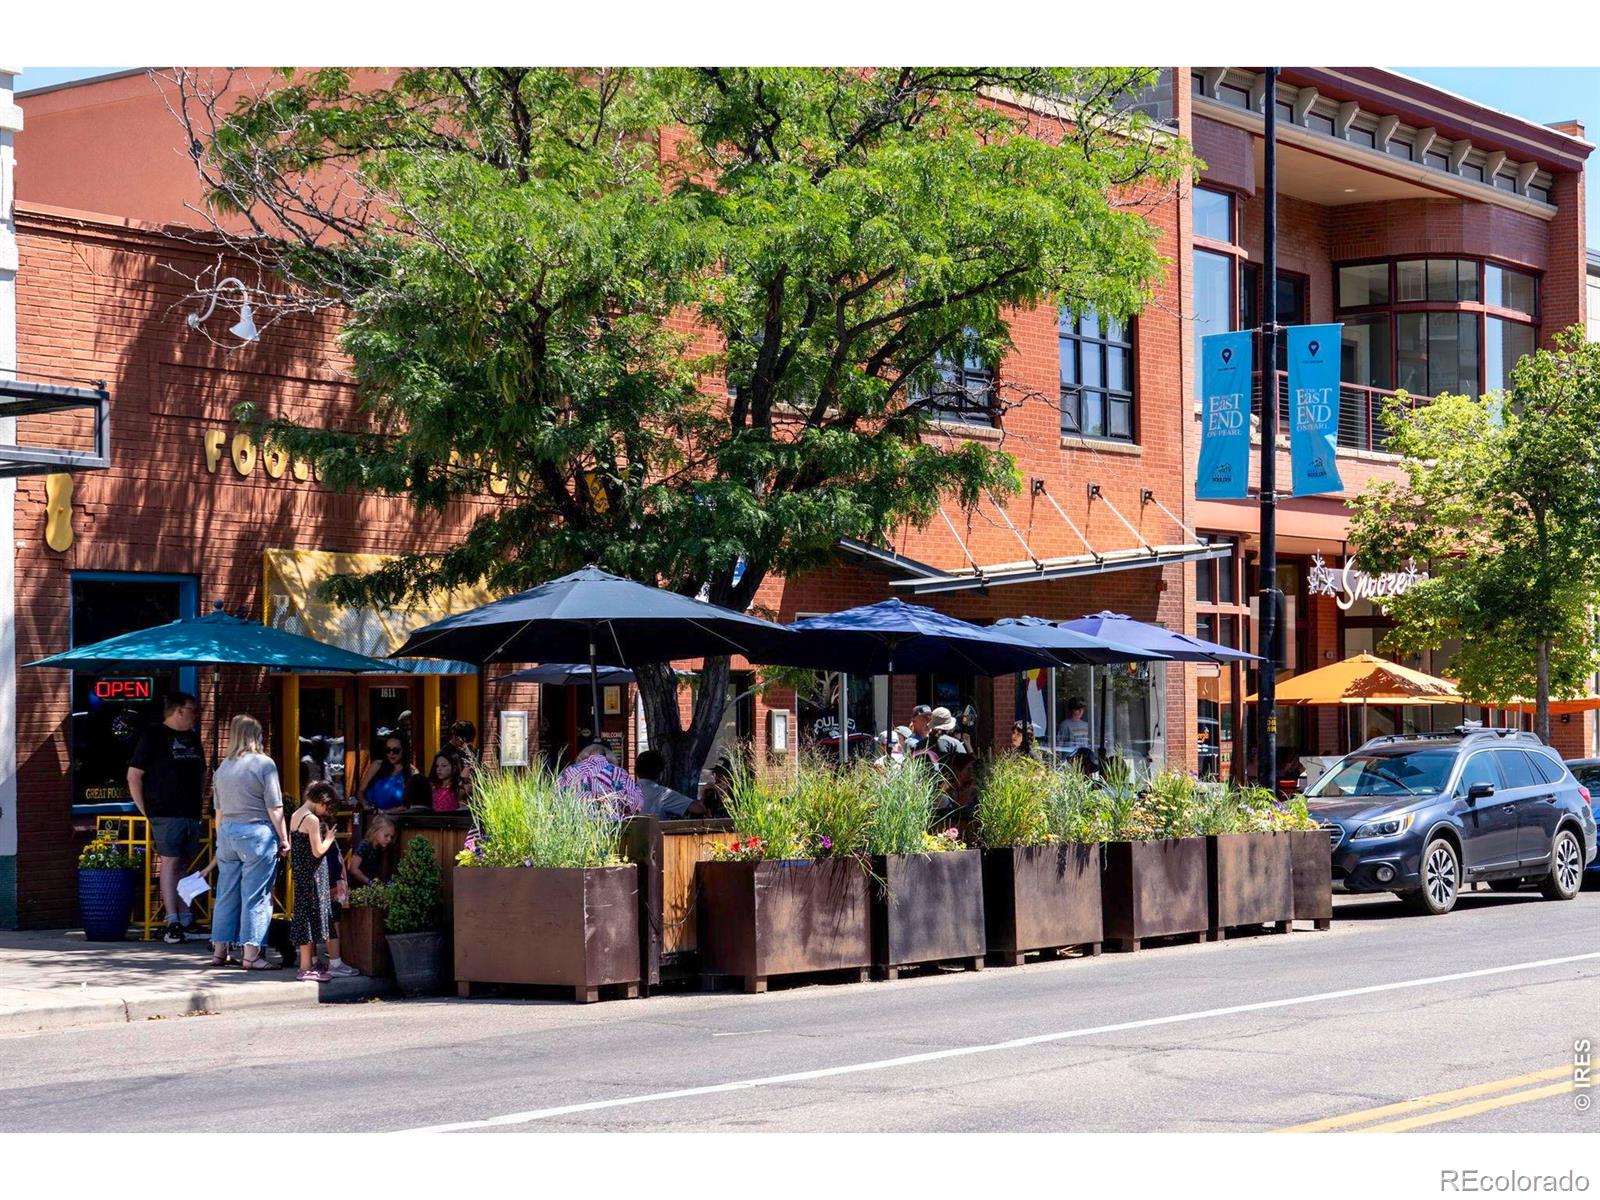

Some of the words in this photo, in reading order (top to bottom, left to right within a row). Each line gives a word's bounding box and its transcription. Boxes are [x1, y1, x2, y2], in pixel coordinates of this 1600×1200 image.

[1208, 411, 1244, 431] END
[1297, 404, 1332, 425] END
[1336, 553, 1407, 610] Snooze
[96, 680, 150, 698] OPEN
[381, 687, 396, 698] 1611
[85, 787, 106, 800] GREAT
